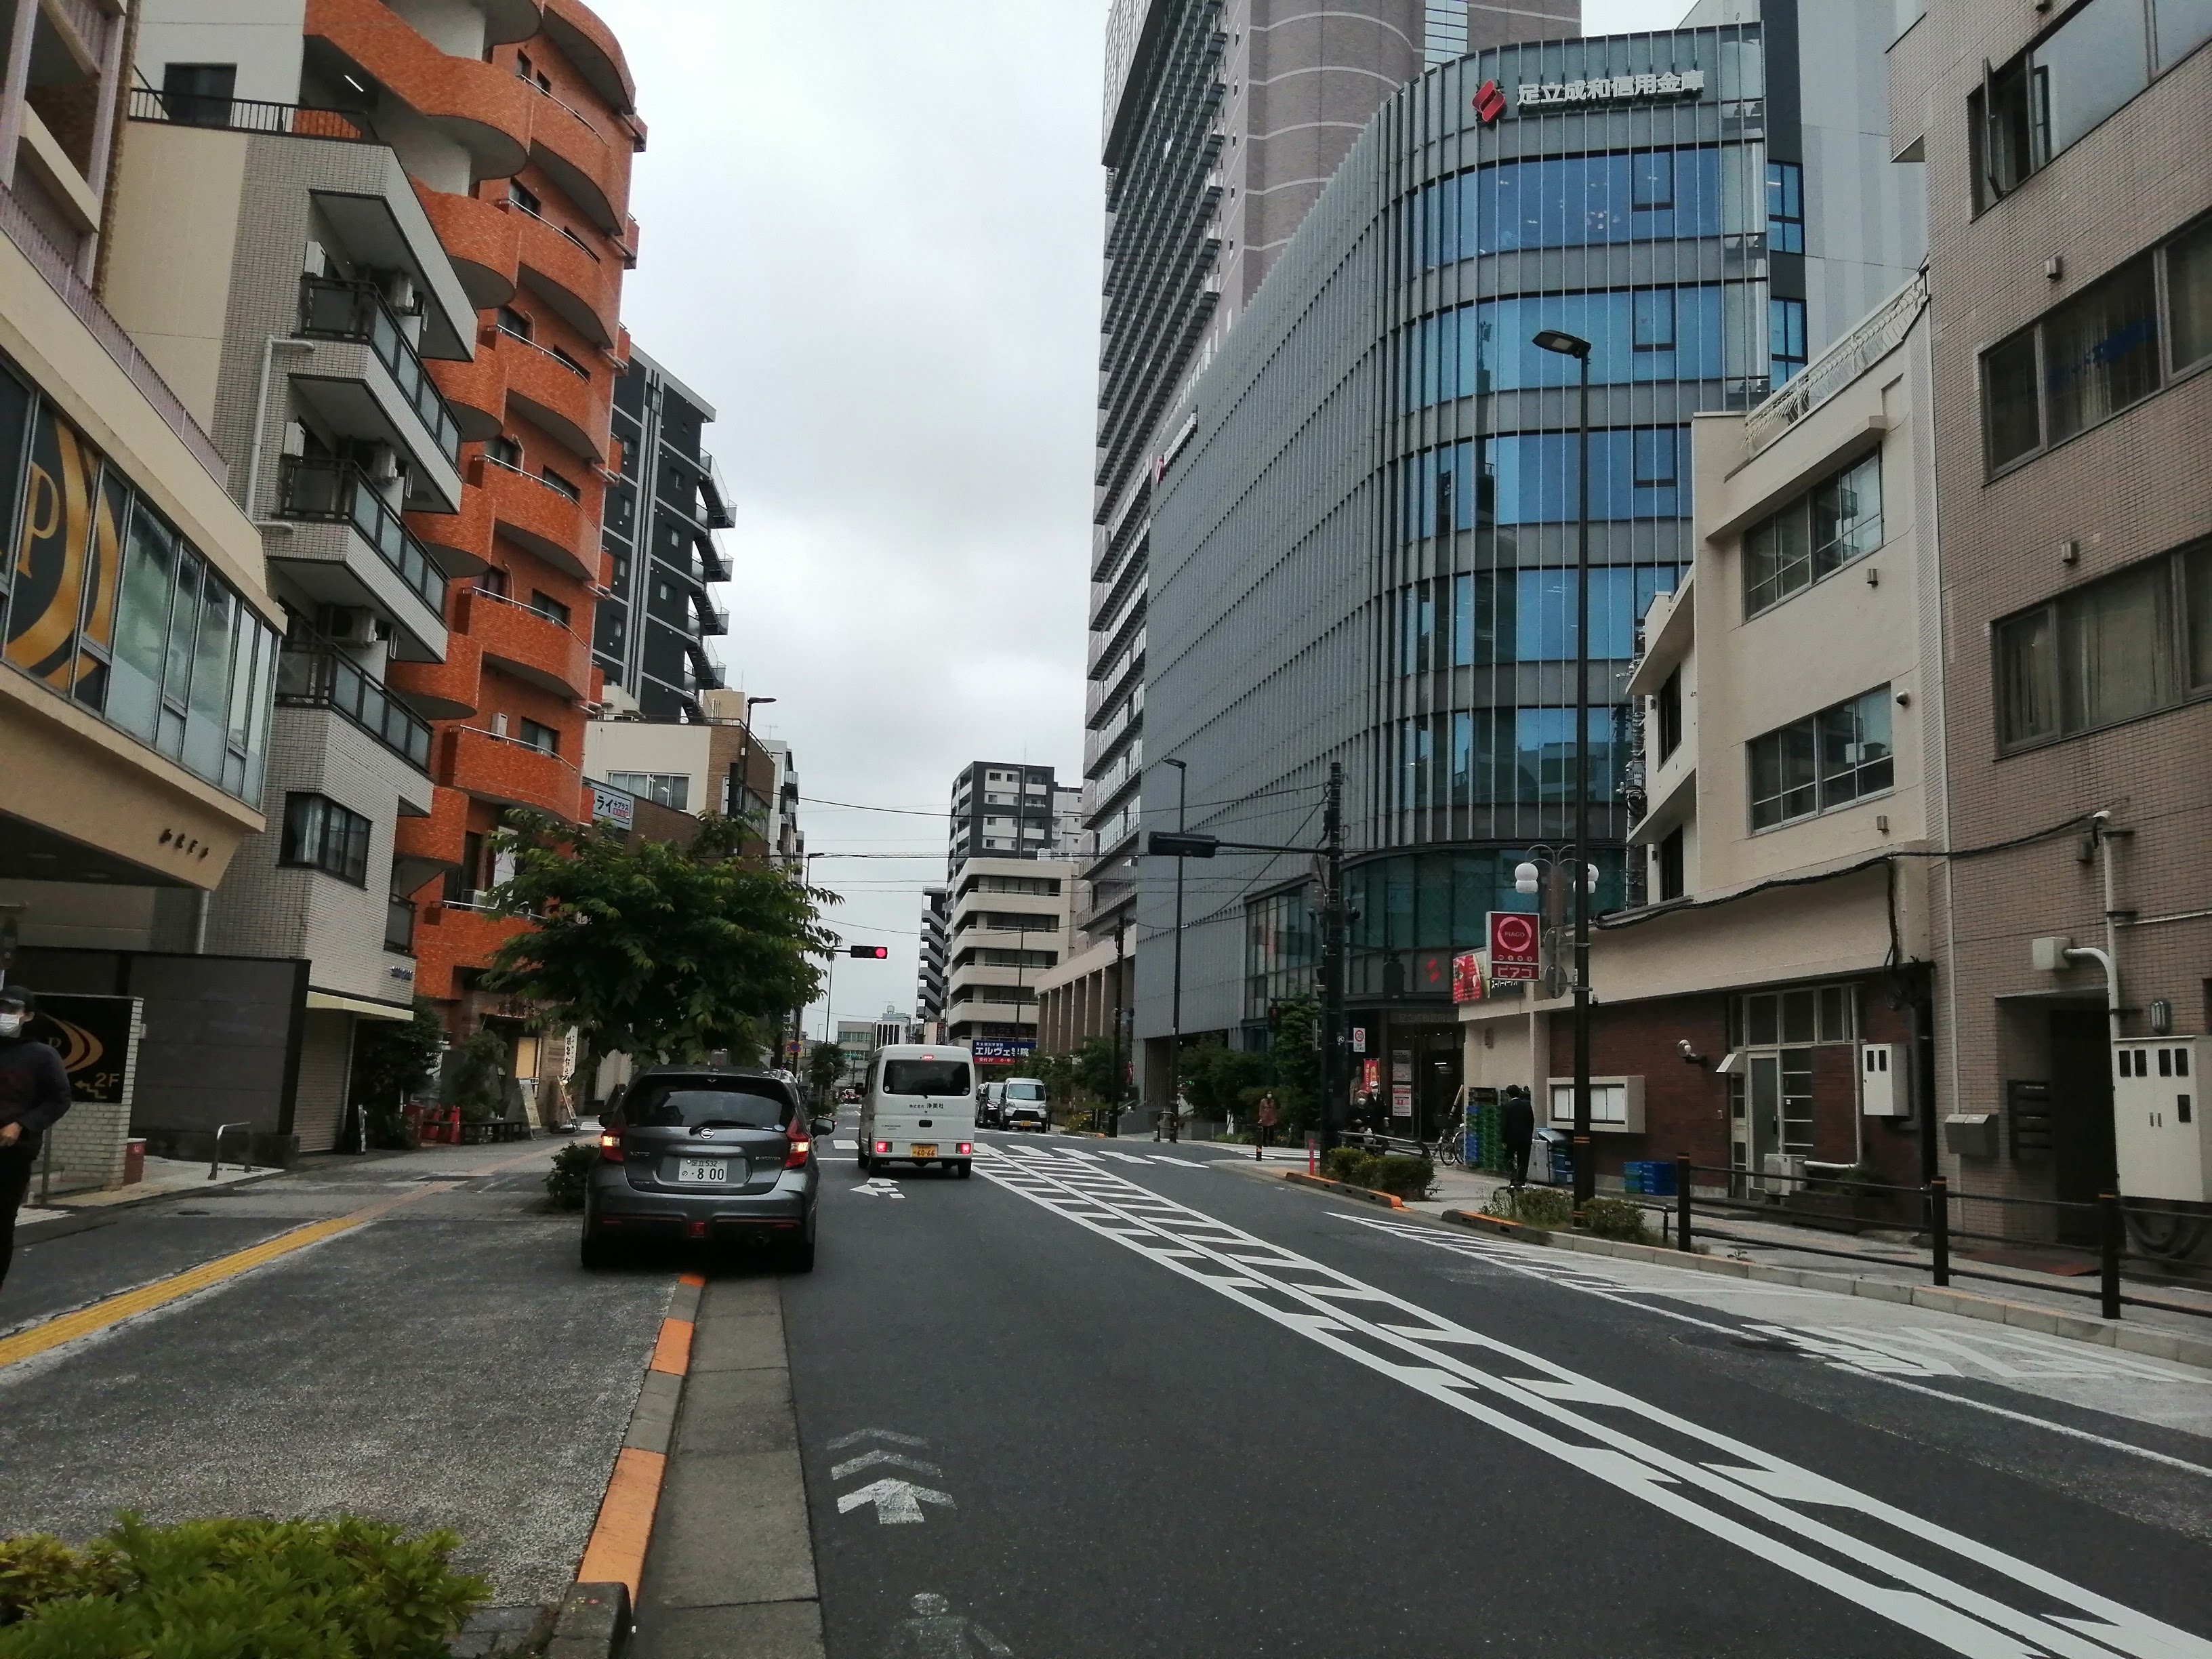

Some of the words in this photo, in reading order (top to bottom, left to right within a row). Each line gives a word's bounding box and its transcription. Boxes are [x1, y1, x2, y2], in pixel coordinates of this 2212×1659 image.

[1517, 70, 1705, 106] 足立成和信用金庫
[594, 795, 613, 813] ライ
[1497, 965, 1533, 979] ピアゴ
[95, 1072, 120, 1087] 2F
